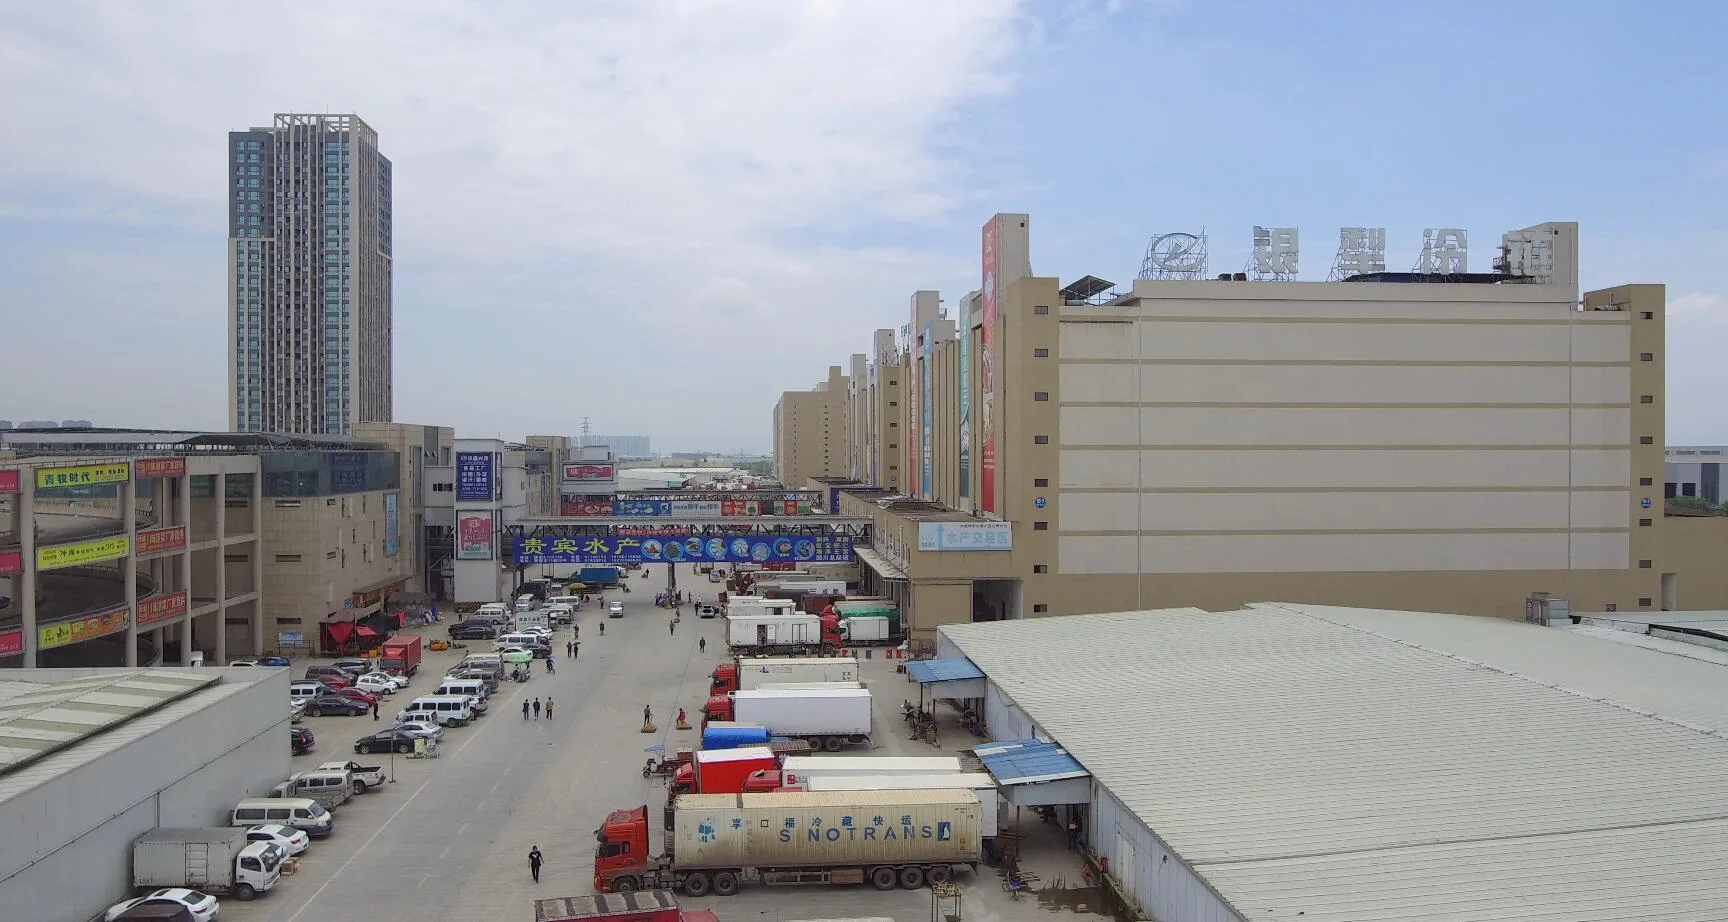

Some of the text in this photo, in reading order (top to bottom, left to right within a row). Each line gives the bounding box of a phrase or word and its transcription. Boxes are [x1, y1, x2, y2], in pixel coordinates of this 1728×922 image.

[947, 530, 1009, 545] 水产交易区
[519, 537, 641, 555] 贵宾水产
